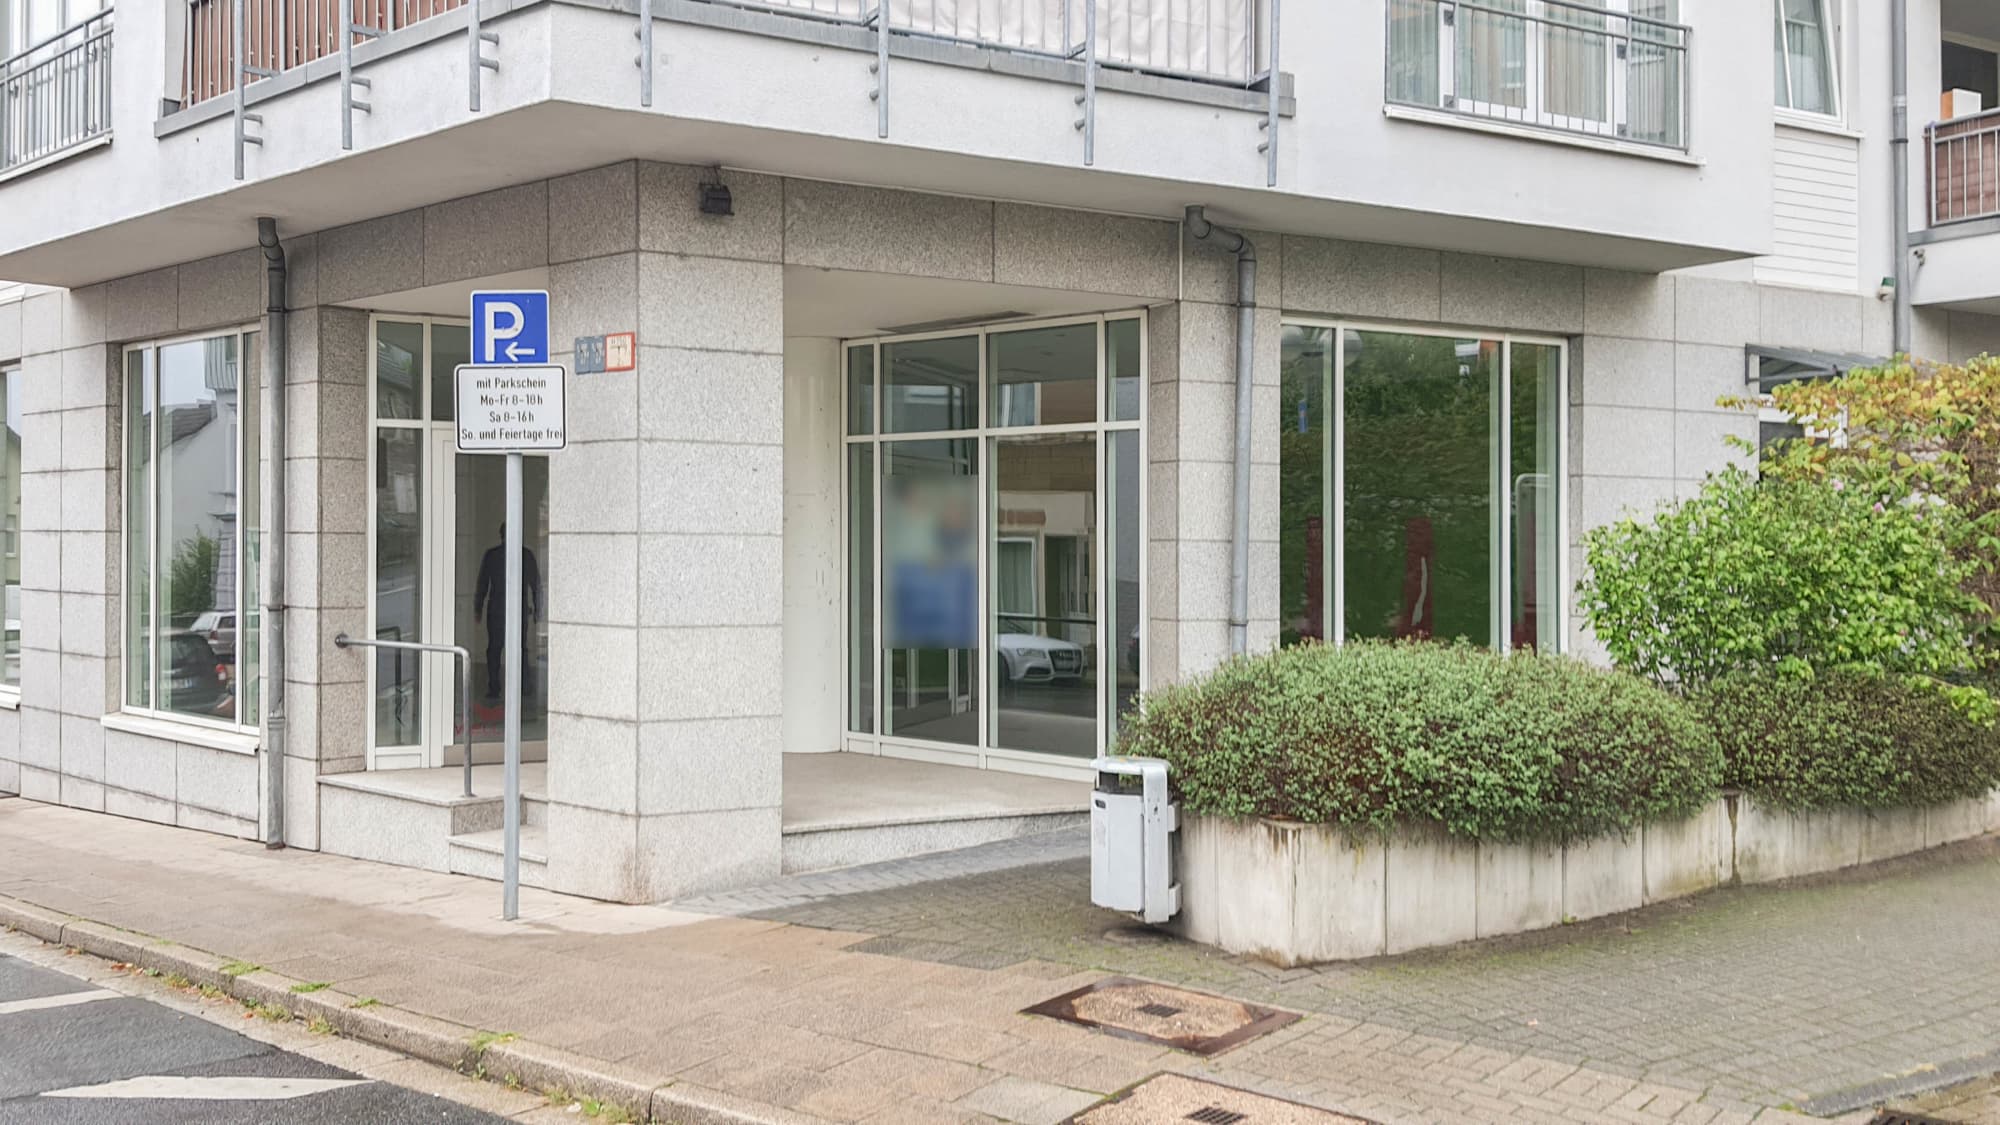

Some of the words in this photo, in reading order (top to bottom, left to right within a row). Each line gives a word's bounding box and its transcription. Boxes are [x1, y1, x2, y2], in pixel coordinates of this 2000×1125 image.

[485, 302, 525, 362] P
[476, 377, 491, 389] mit
[494, 377, 546, 389] Parkschein
[480, 393, 509, 406] Mo-Fr
[489, 410, 501, 423] Sa
[461, 428, 476, 440] So.
[479, 428, 496, 440] und
[499, 428, 544, 442] Feiertage
[546, 427, 563, 440] frei
